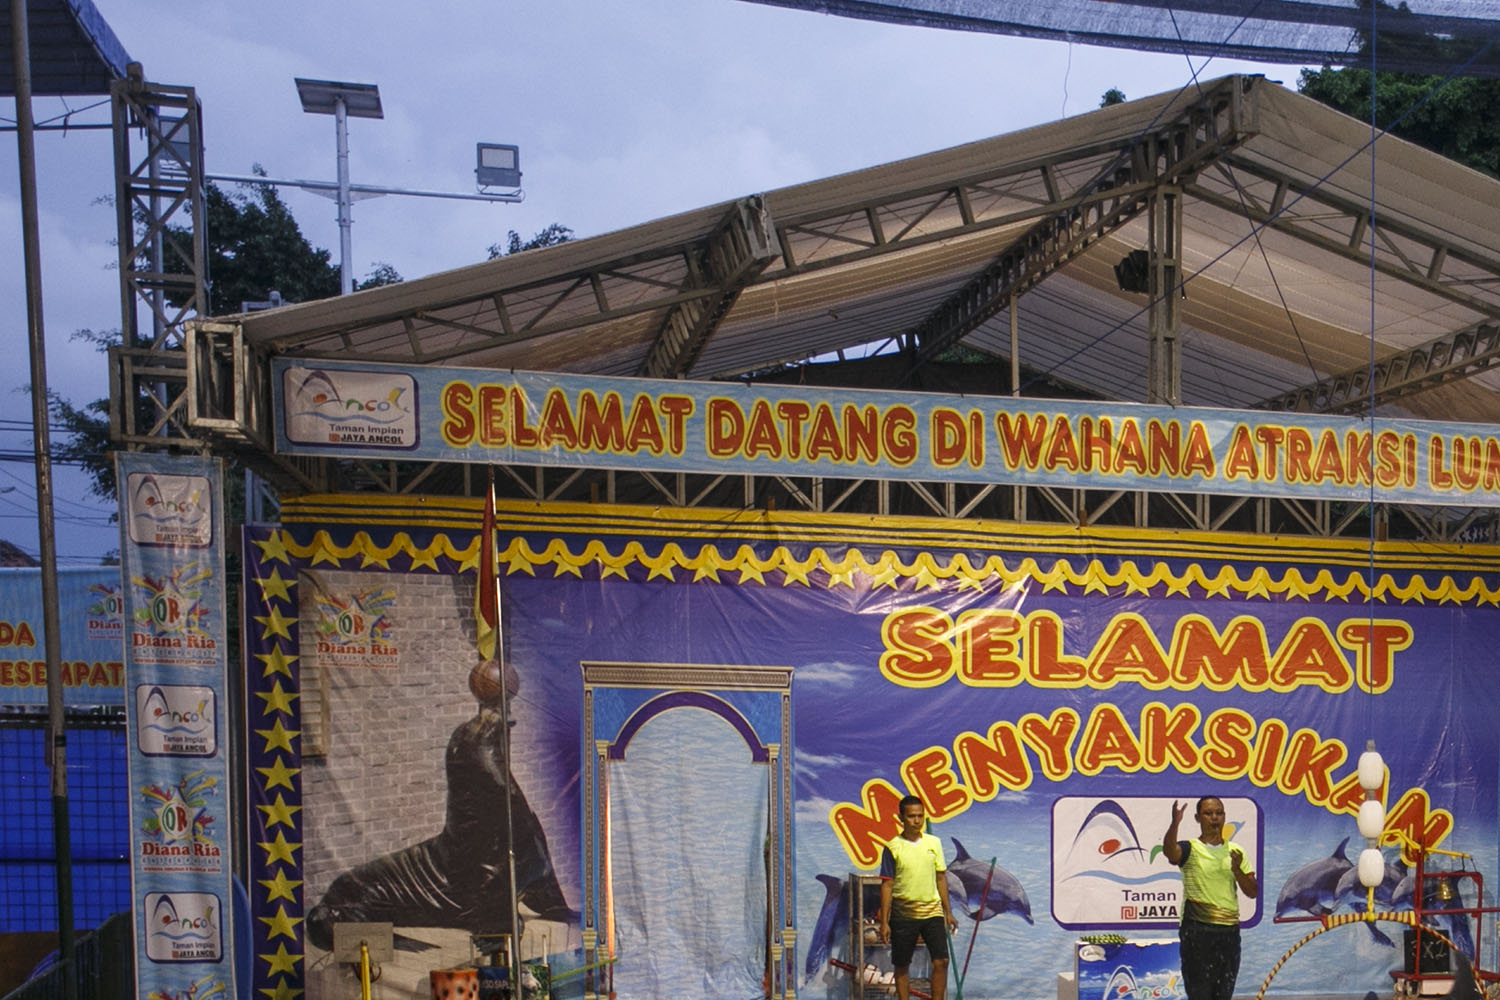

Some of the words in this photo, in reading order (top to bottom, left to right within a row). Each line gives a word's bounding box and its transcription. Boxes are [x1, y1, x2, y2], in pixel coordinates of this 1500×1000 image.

[329, 424, 365, 433] Taman
[367, 426, 404, 435] Impian
[440, 380, 693, 456] SELAMAT
[706, 396, 917, 466] DATANG
[931, 404, 983, 469] DI
[997, 412, 1214, 480] WAHANA
[1226, 424, 1416, 491] ATRAKSI
[341, 434, 366, 443] JAYA
[368, 435, 403, 445] ANCOL
[88, 619, 123, 629] Dian
[133, 633, 182, 647] Diana
[187, 635, 216, 648] Ria
[318, 642, 366, 654] Diana
[371, 645, 398, 655] Ria
[880, 607, 1412, 695] SELAMAT
[0, 661, 125, 687] ESEPAT
[830, 703, 1453, 870] MENYAKSIKAN
[142, 842, 190, 856] Diana
[194, 843, 220, 856] Ria
[1122, 889, 1177, 902] Taman
[1139, 905, 1178, 917] JAYA
[172, 941, 194, 949] Taman
